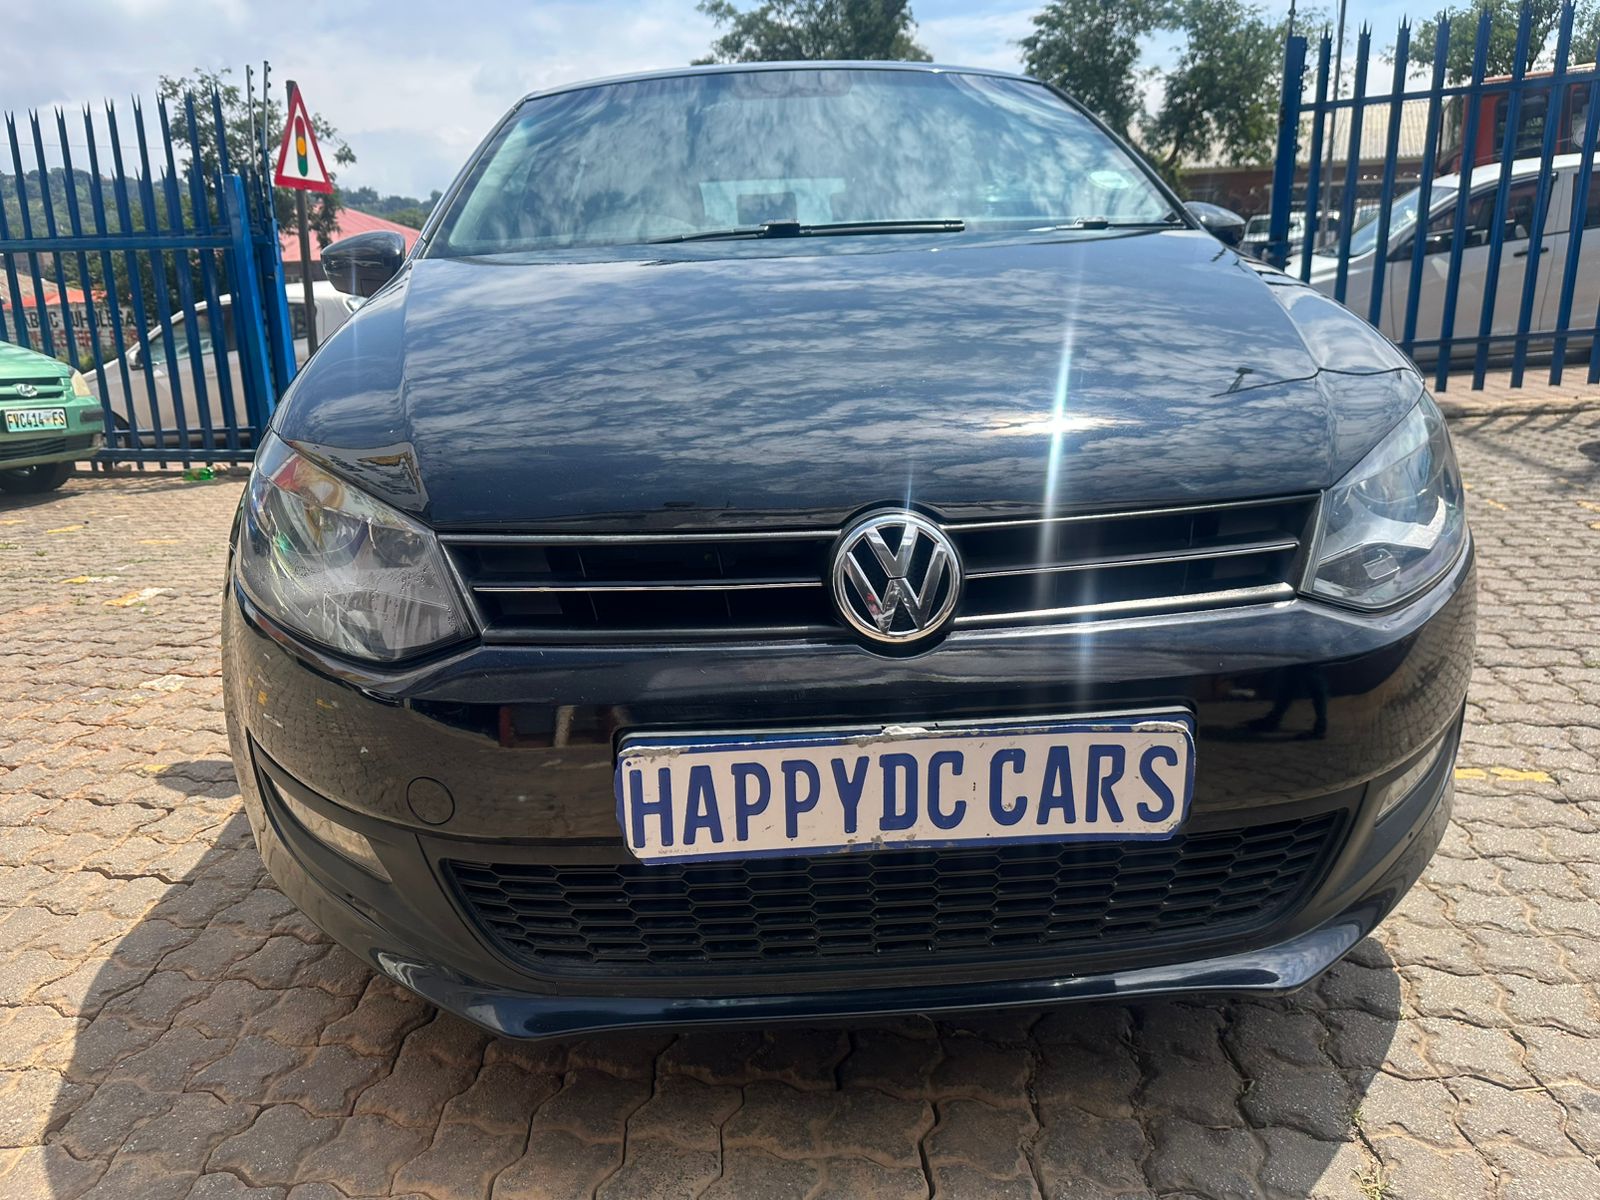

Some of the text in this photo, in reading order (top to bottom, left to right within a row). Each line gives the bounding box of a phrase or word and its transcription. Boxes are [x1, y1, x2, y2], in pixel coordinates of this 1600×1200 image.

[52, 411, 65, 427] FS
[629, 744, 1178, 849] HAPPYDC CARS
